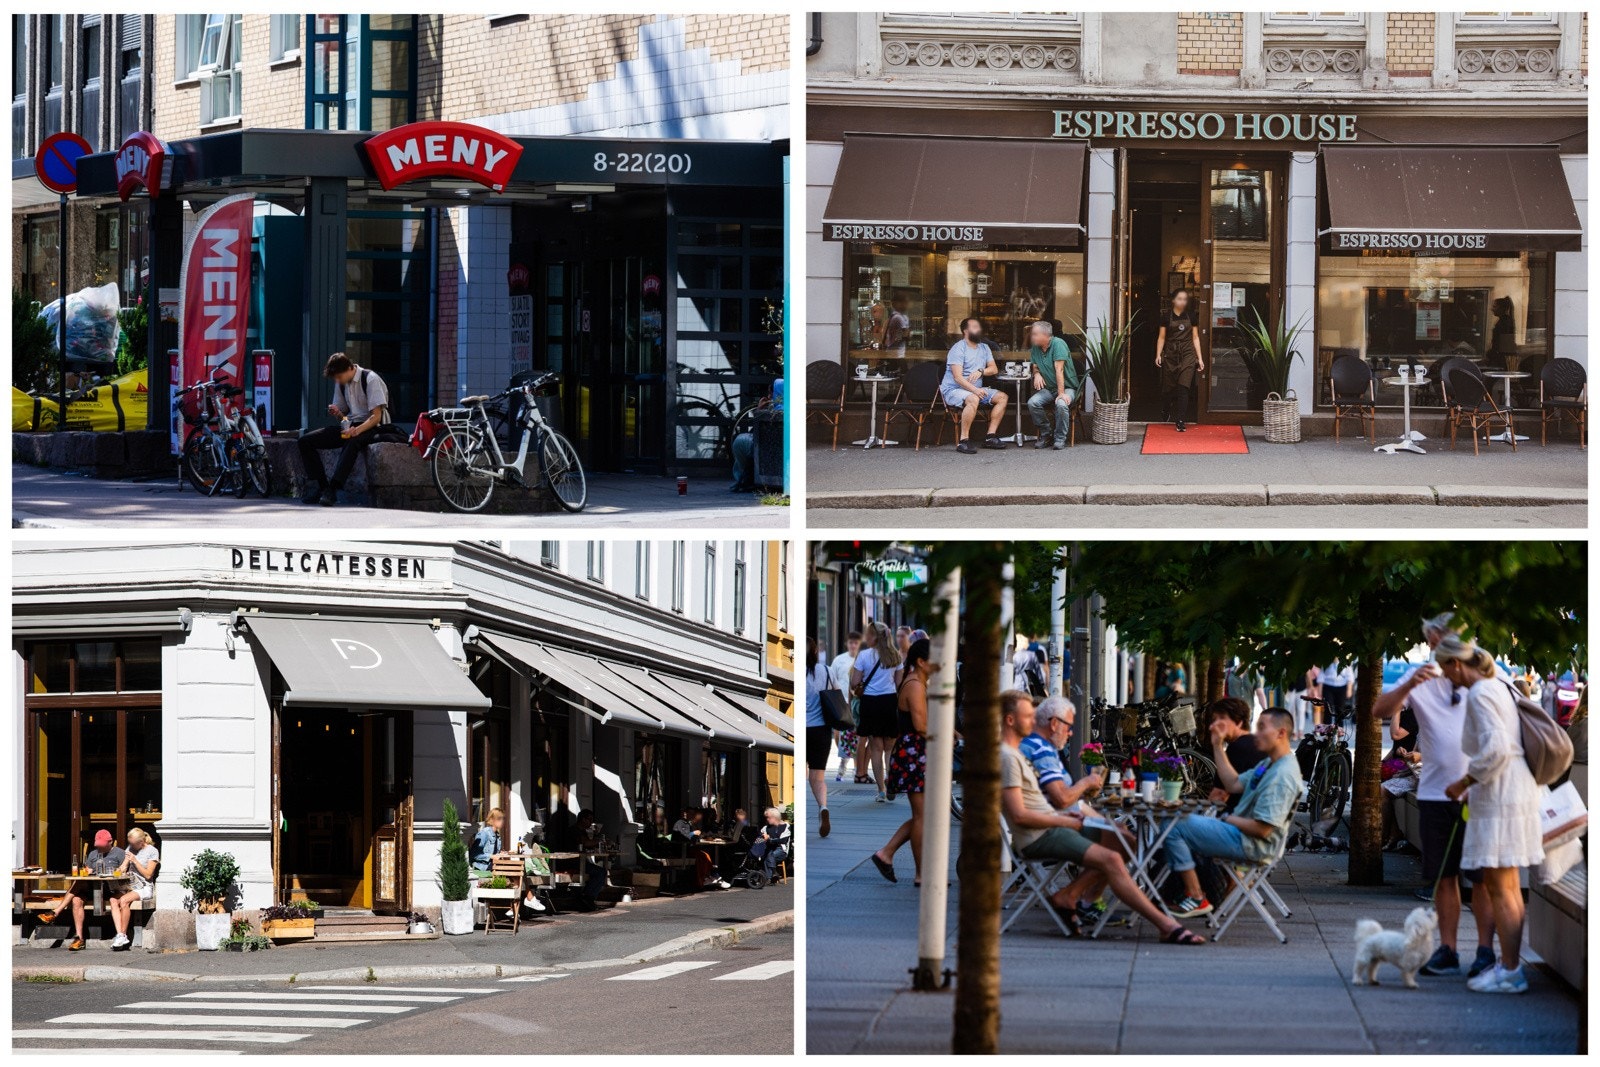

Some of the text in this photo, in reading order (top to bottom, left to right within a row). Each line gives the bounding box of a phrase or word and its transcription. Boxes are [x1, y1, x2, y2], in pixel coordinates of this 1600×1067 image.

[1052, 110, 1358, 142] ESPRESSO HOUSE
[116, 145, 150, 182] MENY
[386, 135, 508, 172] MENY
[593, 152, 692, 174] 8-22(20)
[831, 225, 983, 241] ESPRESSO HOUSE
[1339, 233, 1486, 249] ESPRESSO HOUSE
[643, 279, 659, 291] MENY
[202, 229, 239, 378] MENY
[231, 549, 425, 578] DELICATESSEN
